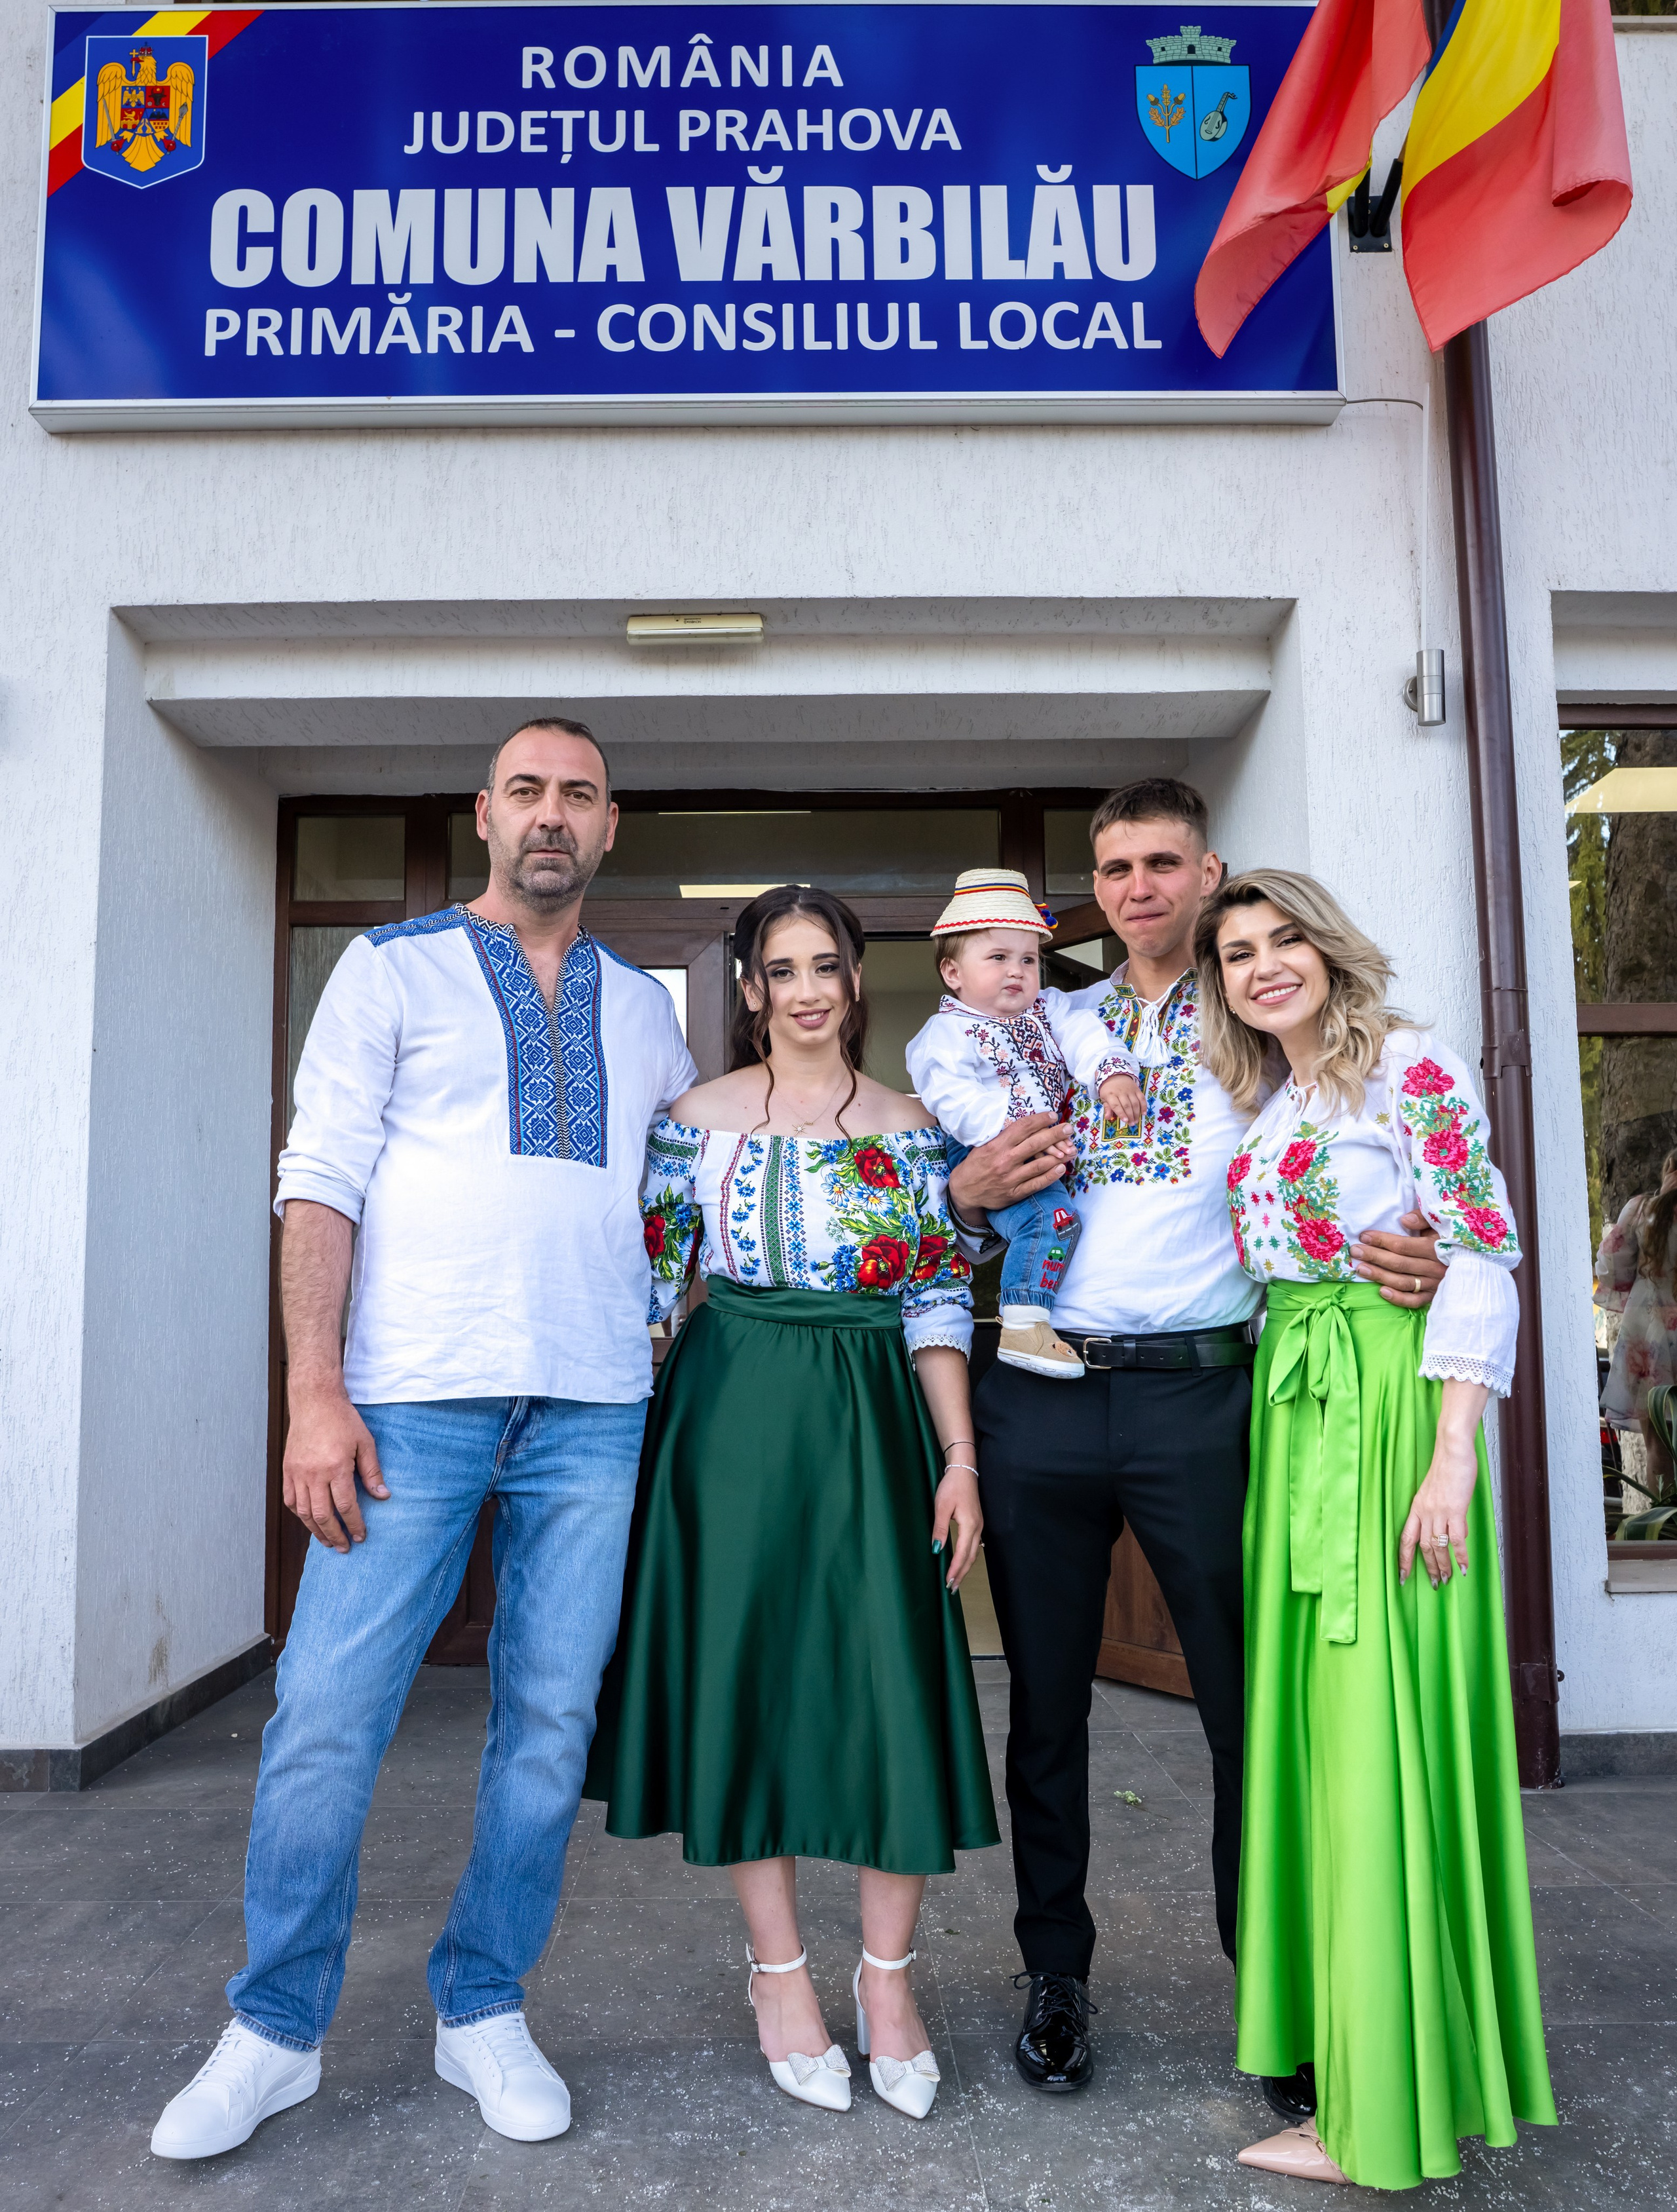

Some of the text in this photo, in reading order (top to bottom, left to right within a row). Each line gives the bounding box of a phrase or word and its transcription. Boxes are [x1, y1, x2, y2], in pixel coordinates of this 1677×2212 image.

[522, 33, 844, 88] ROMÂNIA
[404, 108, 962, 164] JUDEȚUL PRAHOVA
[210, 164, 1156, 288] COMUNA VĂRBILĂU
[204, 292, 1162, 356] PRIMĂRIA - CONSILIUL LOCAL
